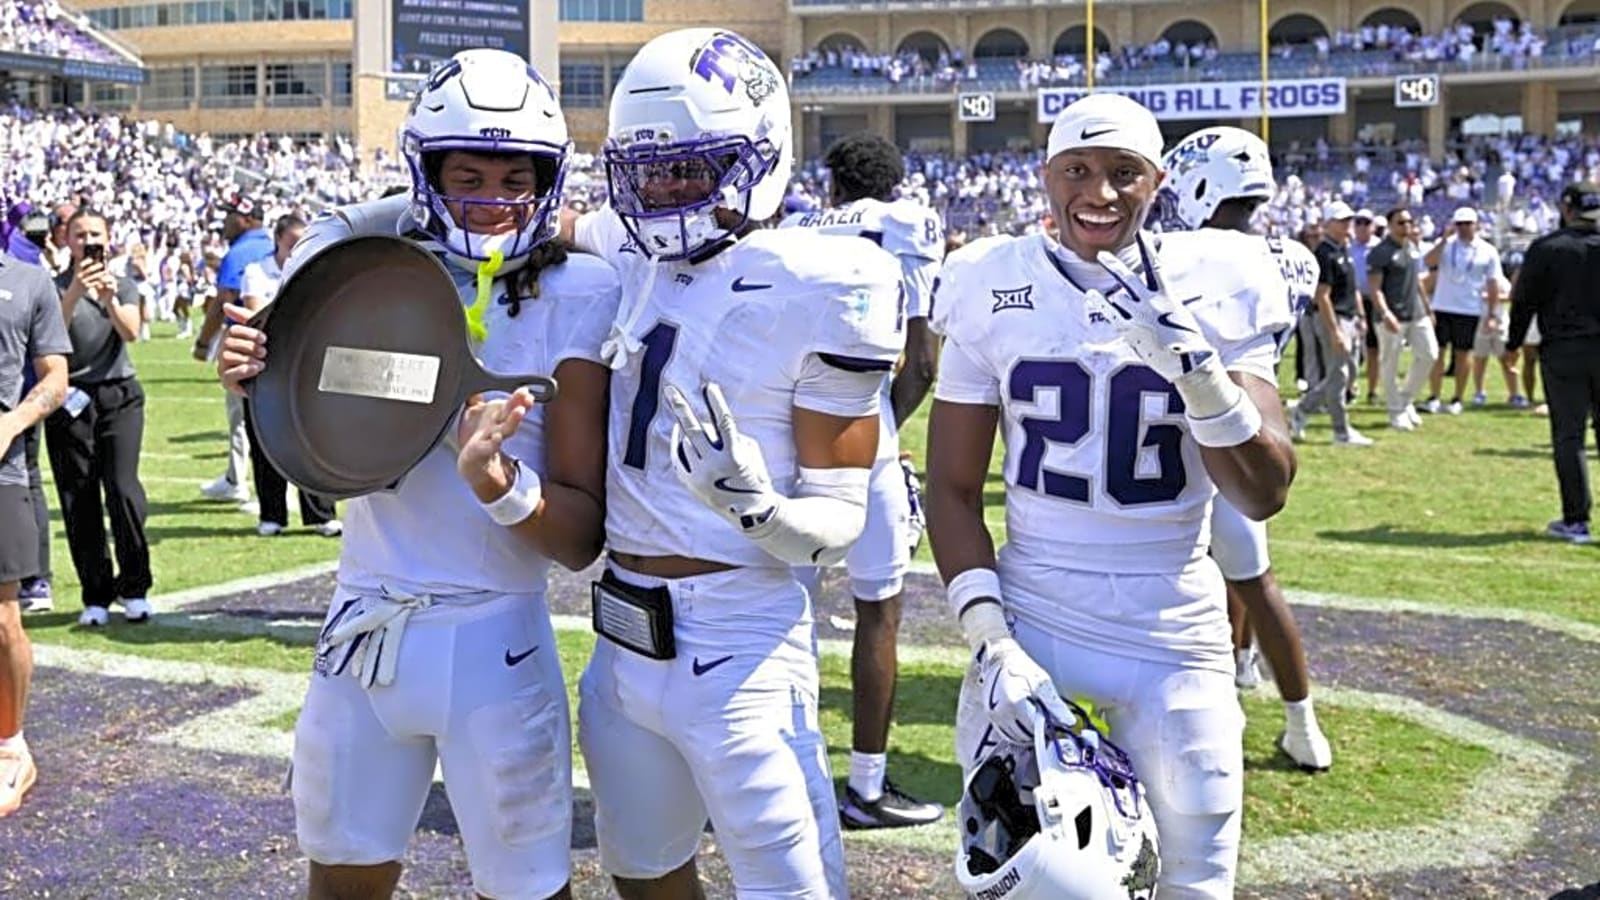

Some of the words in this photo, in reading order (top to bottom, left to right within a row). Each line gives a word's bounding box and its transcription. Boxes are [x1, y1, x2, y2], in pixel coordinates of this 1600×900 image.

[1175, 88, 1231, 111] ALL
[1239, 83, 1341, 110] FROGS
[1401, 78, 1433, 101] 40
[963, 96, 990, 116] 40
[634, 129, 655, 141] TCU
[622, 317, 680, 476] 1
[1008, 356, 1189, 509] 26
